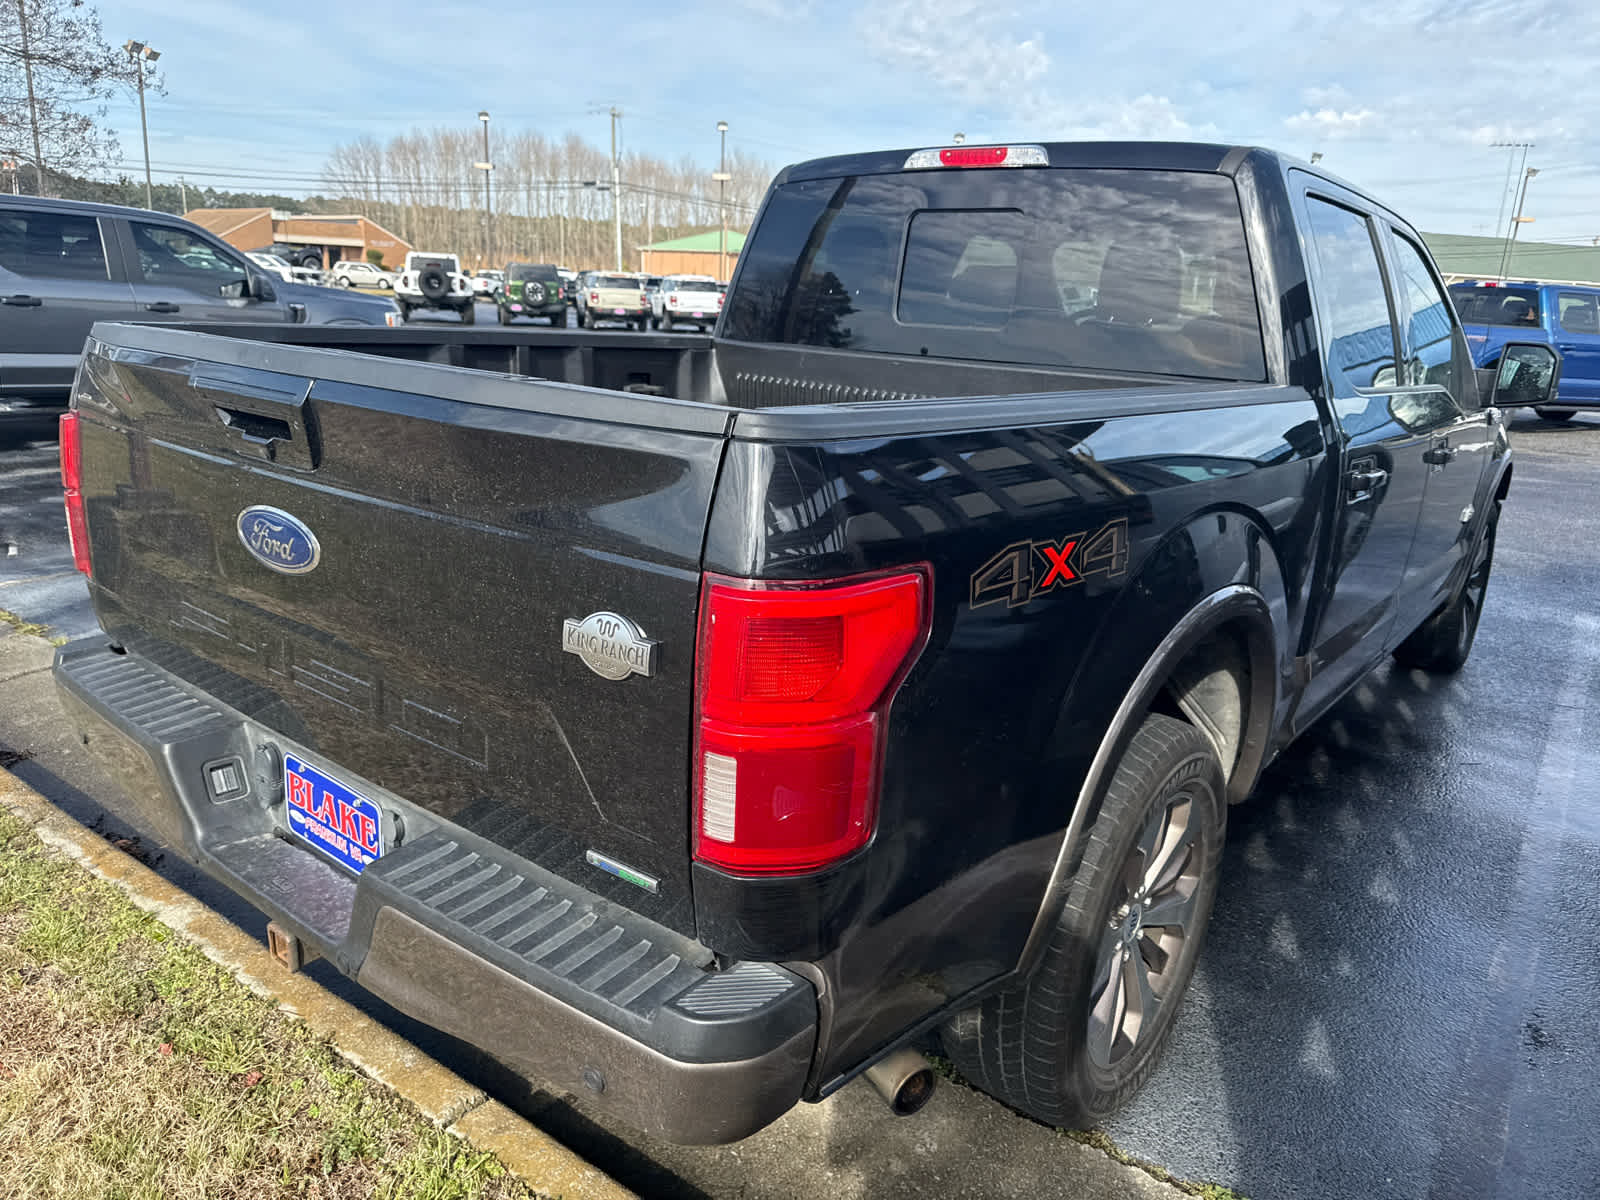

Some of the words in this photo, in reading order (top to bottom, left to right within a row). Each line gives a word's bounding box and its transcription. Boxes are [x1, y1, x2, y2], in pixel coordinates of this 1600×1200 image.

[251, 518, 296, 561] Ford
[567, 626, 598, 653] KING
[601, 639, 646, 667] RANCH
[288, 769, 379, 857] BLAKE
